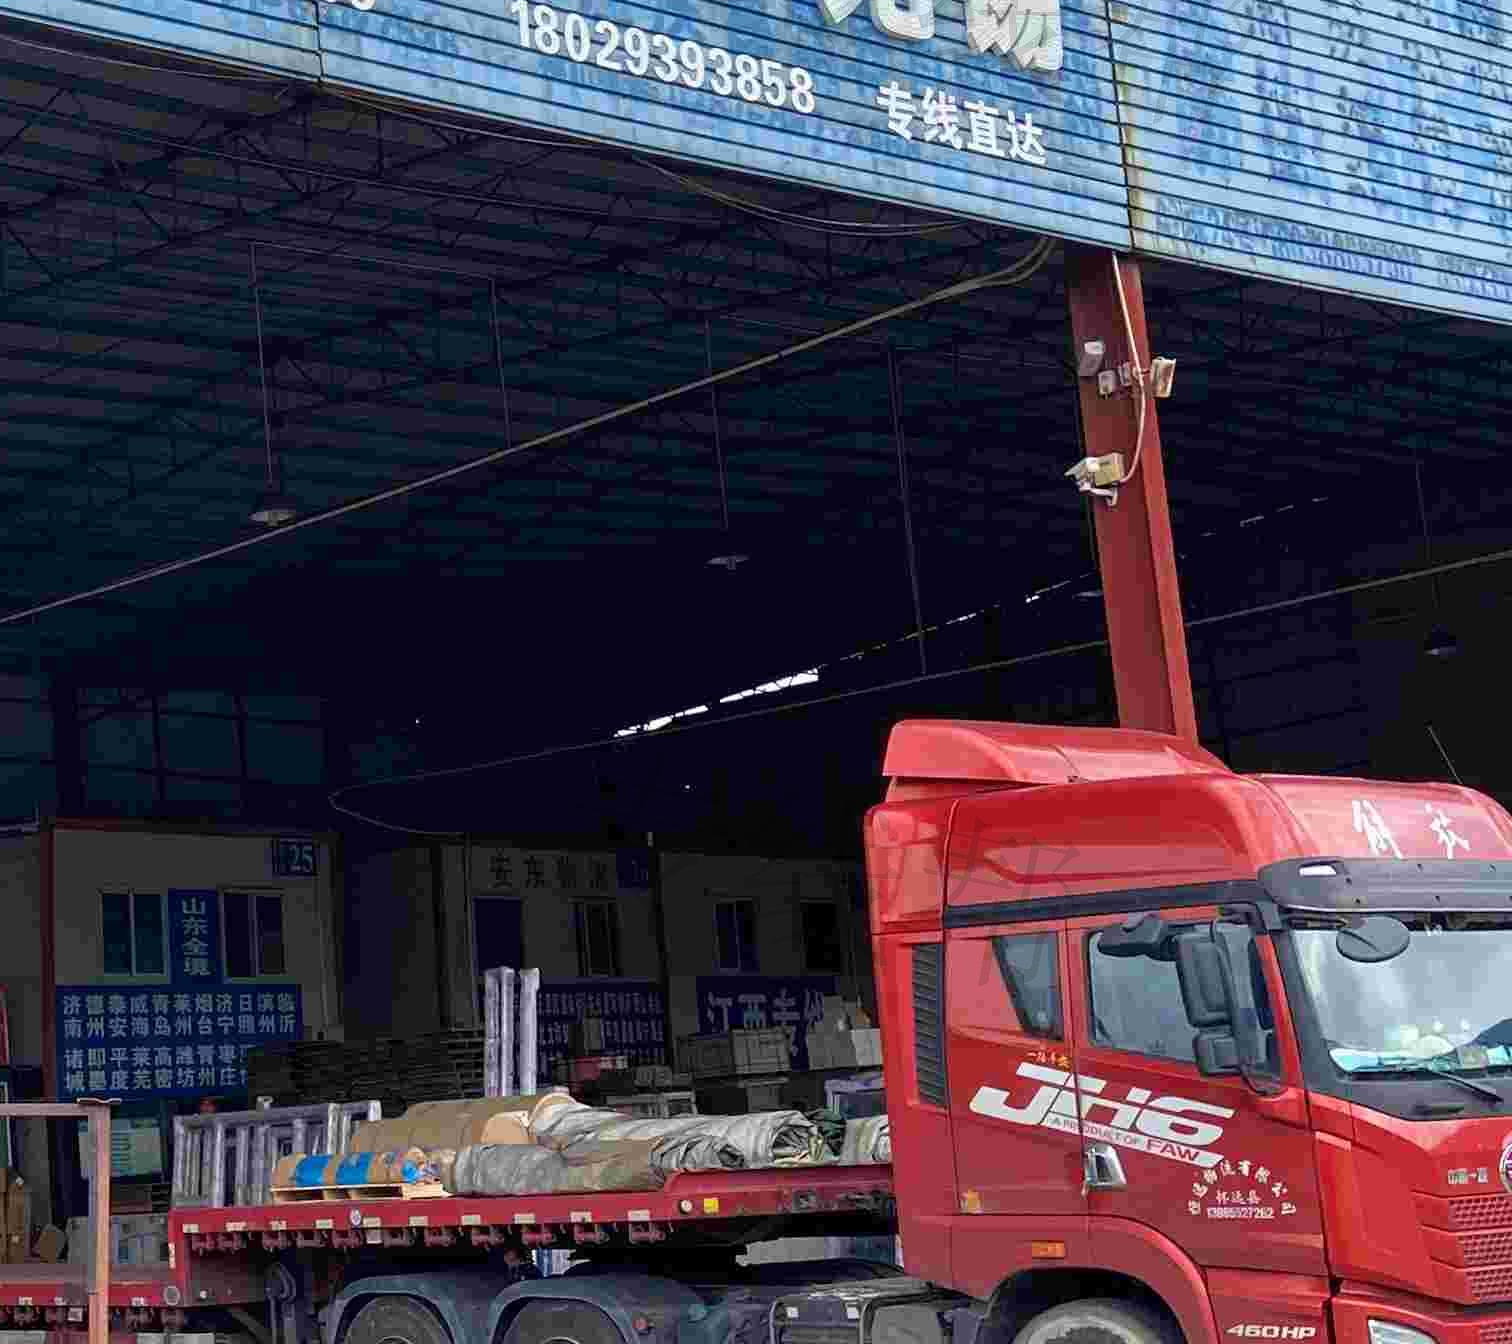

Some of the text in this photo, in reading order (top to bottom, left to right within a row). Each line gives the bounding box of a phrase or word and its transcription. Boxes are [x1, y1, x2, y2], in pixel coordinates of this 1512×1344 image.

[876, 81, 1047, 165] 专线直达
[1146, 1138, 1201, 1163] FAW
[1226, 1323, 1316, 1339] 460HP
